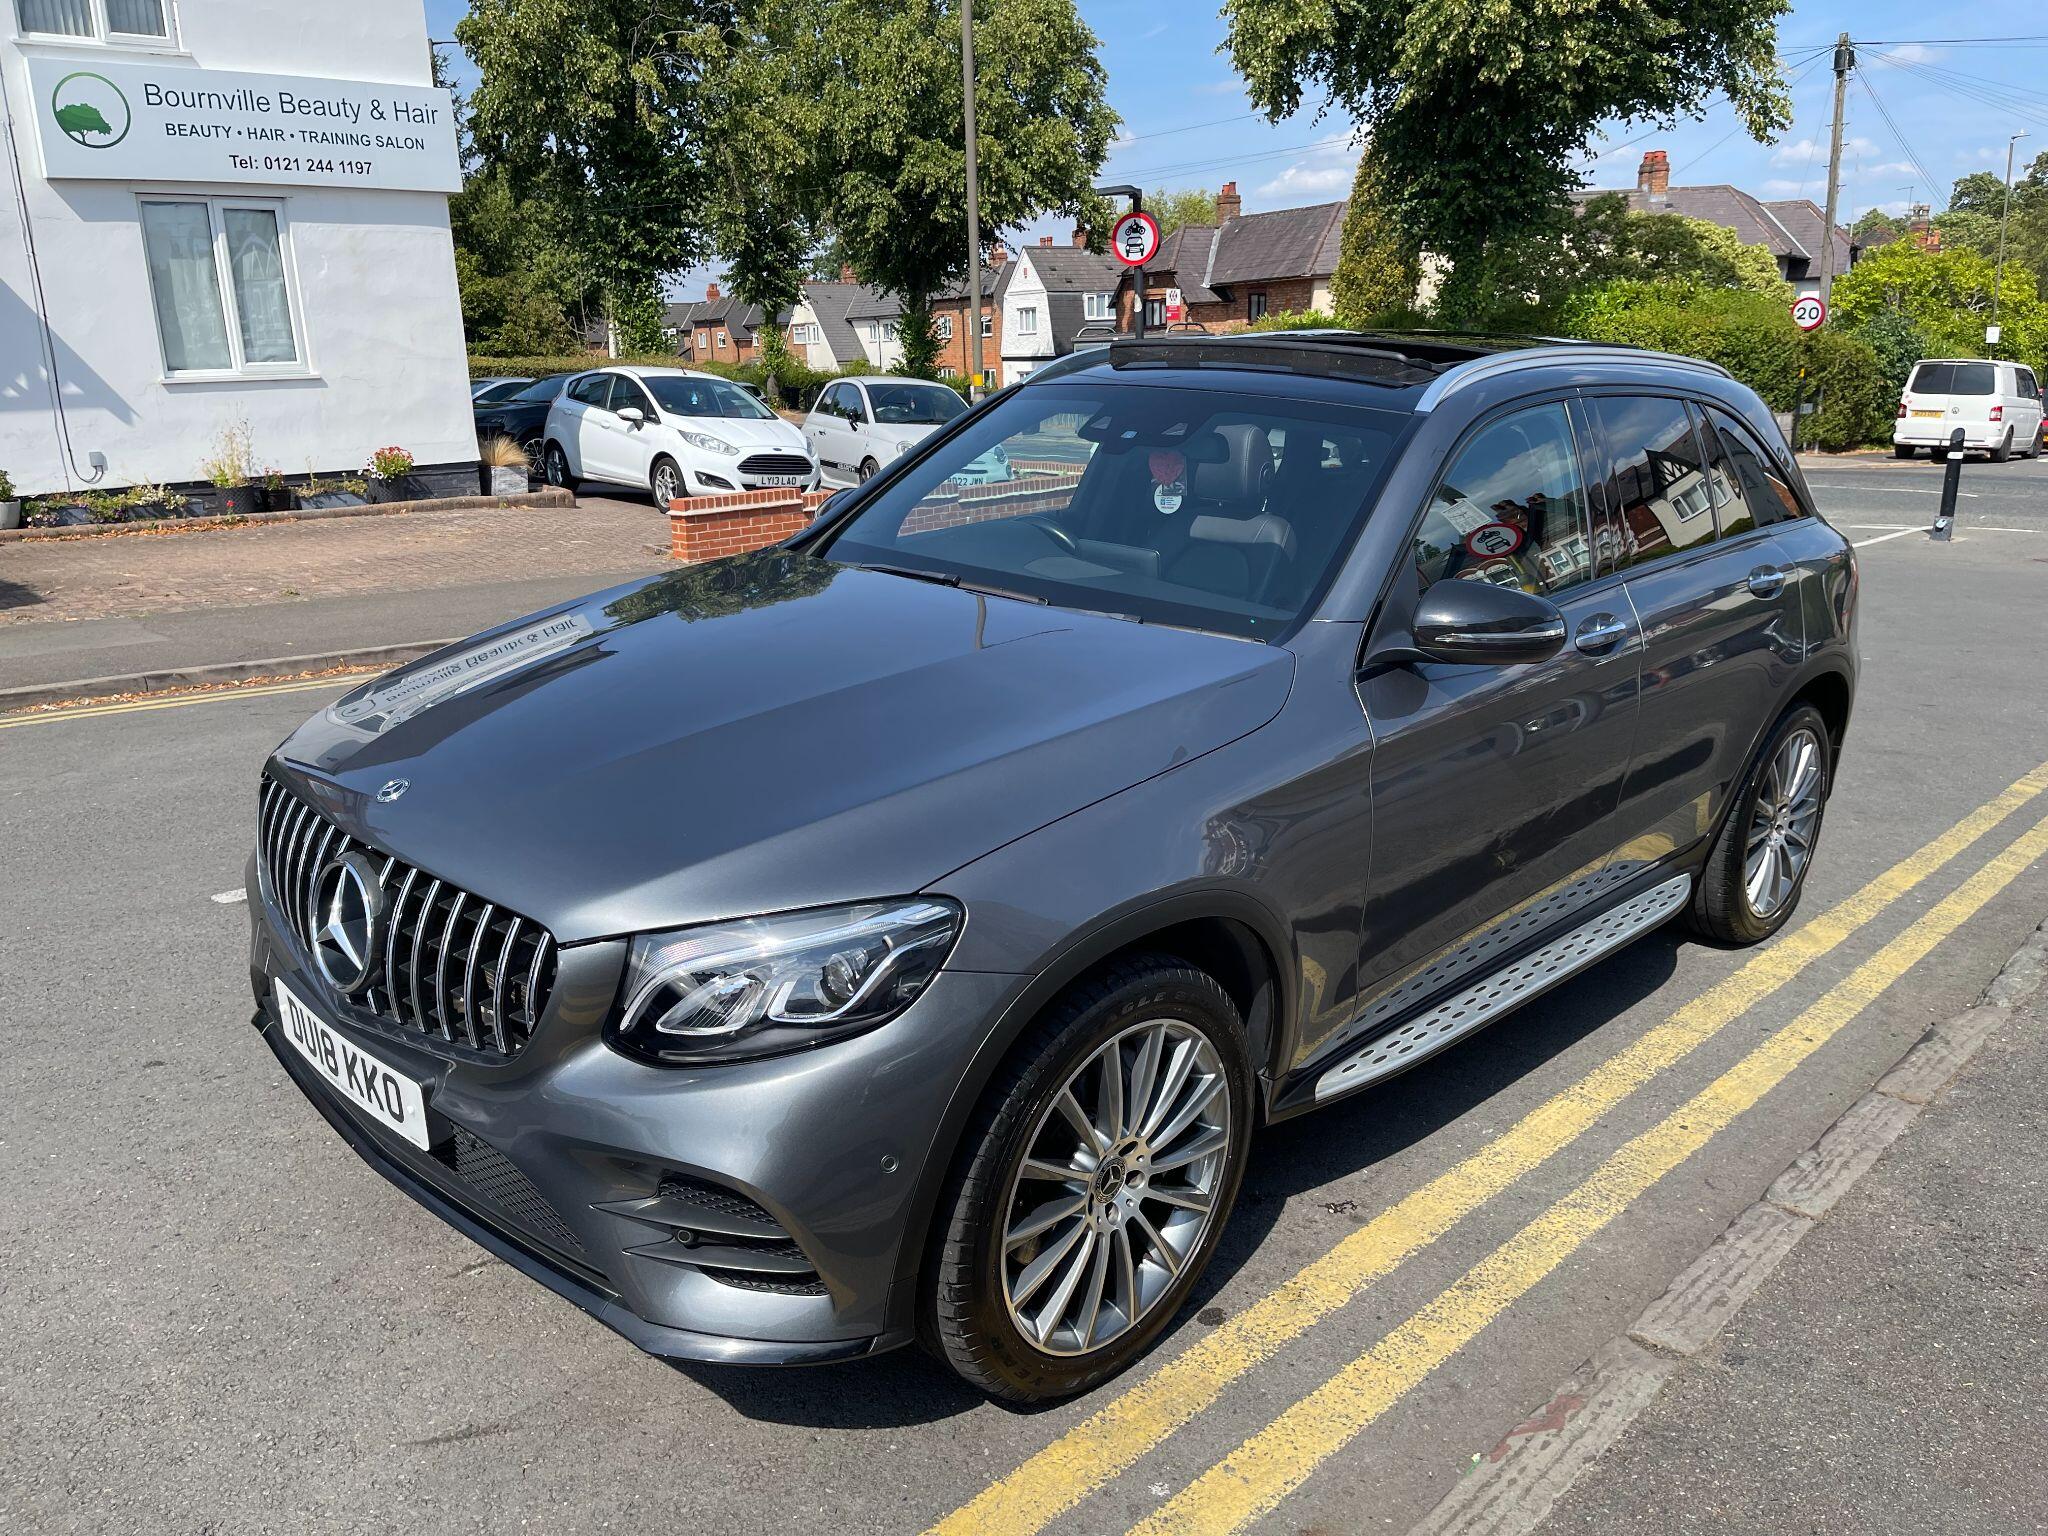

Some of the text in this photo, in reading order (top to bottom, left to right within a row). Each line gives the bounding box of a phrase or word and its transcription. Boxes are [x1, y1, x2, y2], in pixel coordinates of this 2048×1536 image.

[144, 83, 438, 124] Bournville Beauty & Hair
[165, 123, 425, 150] BEAUTY HAIR TRAINING SALON
[229, 155, 372, 175] Tel: 0121 244 1197
[1796, 306, 1820, 320] 20
[287, 995, 405, 1124] DU18 KKO
